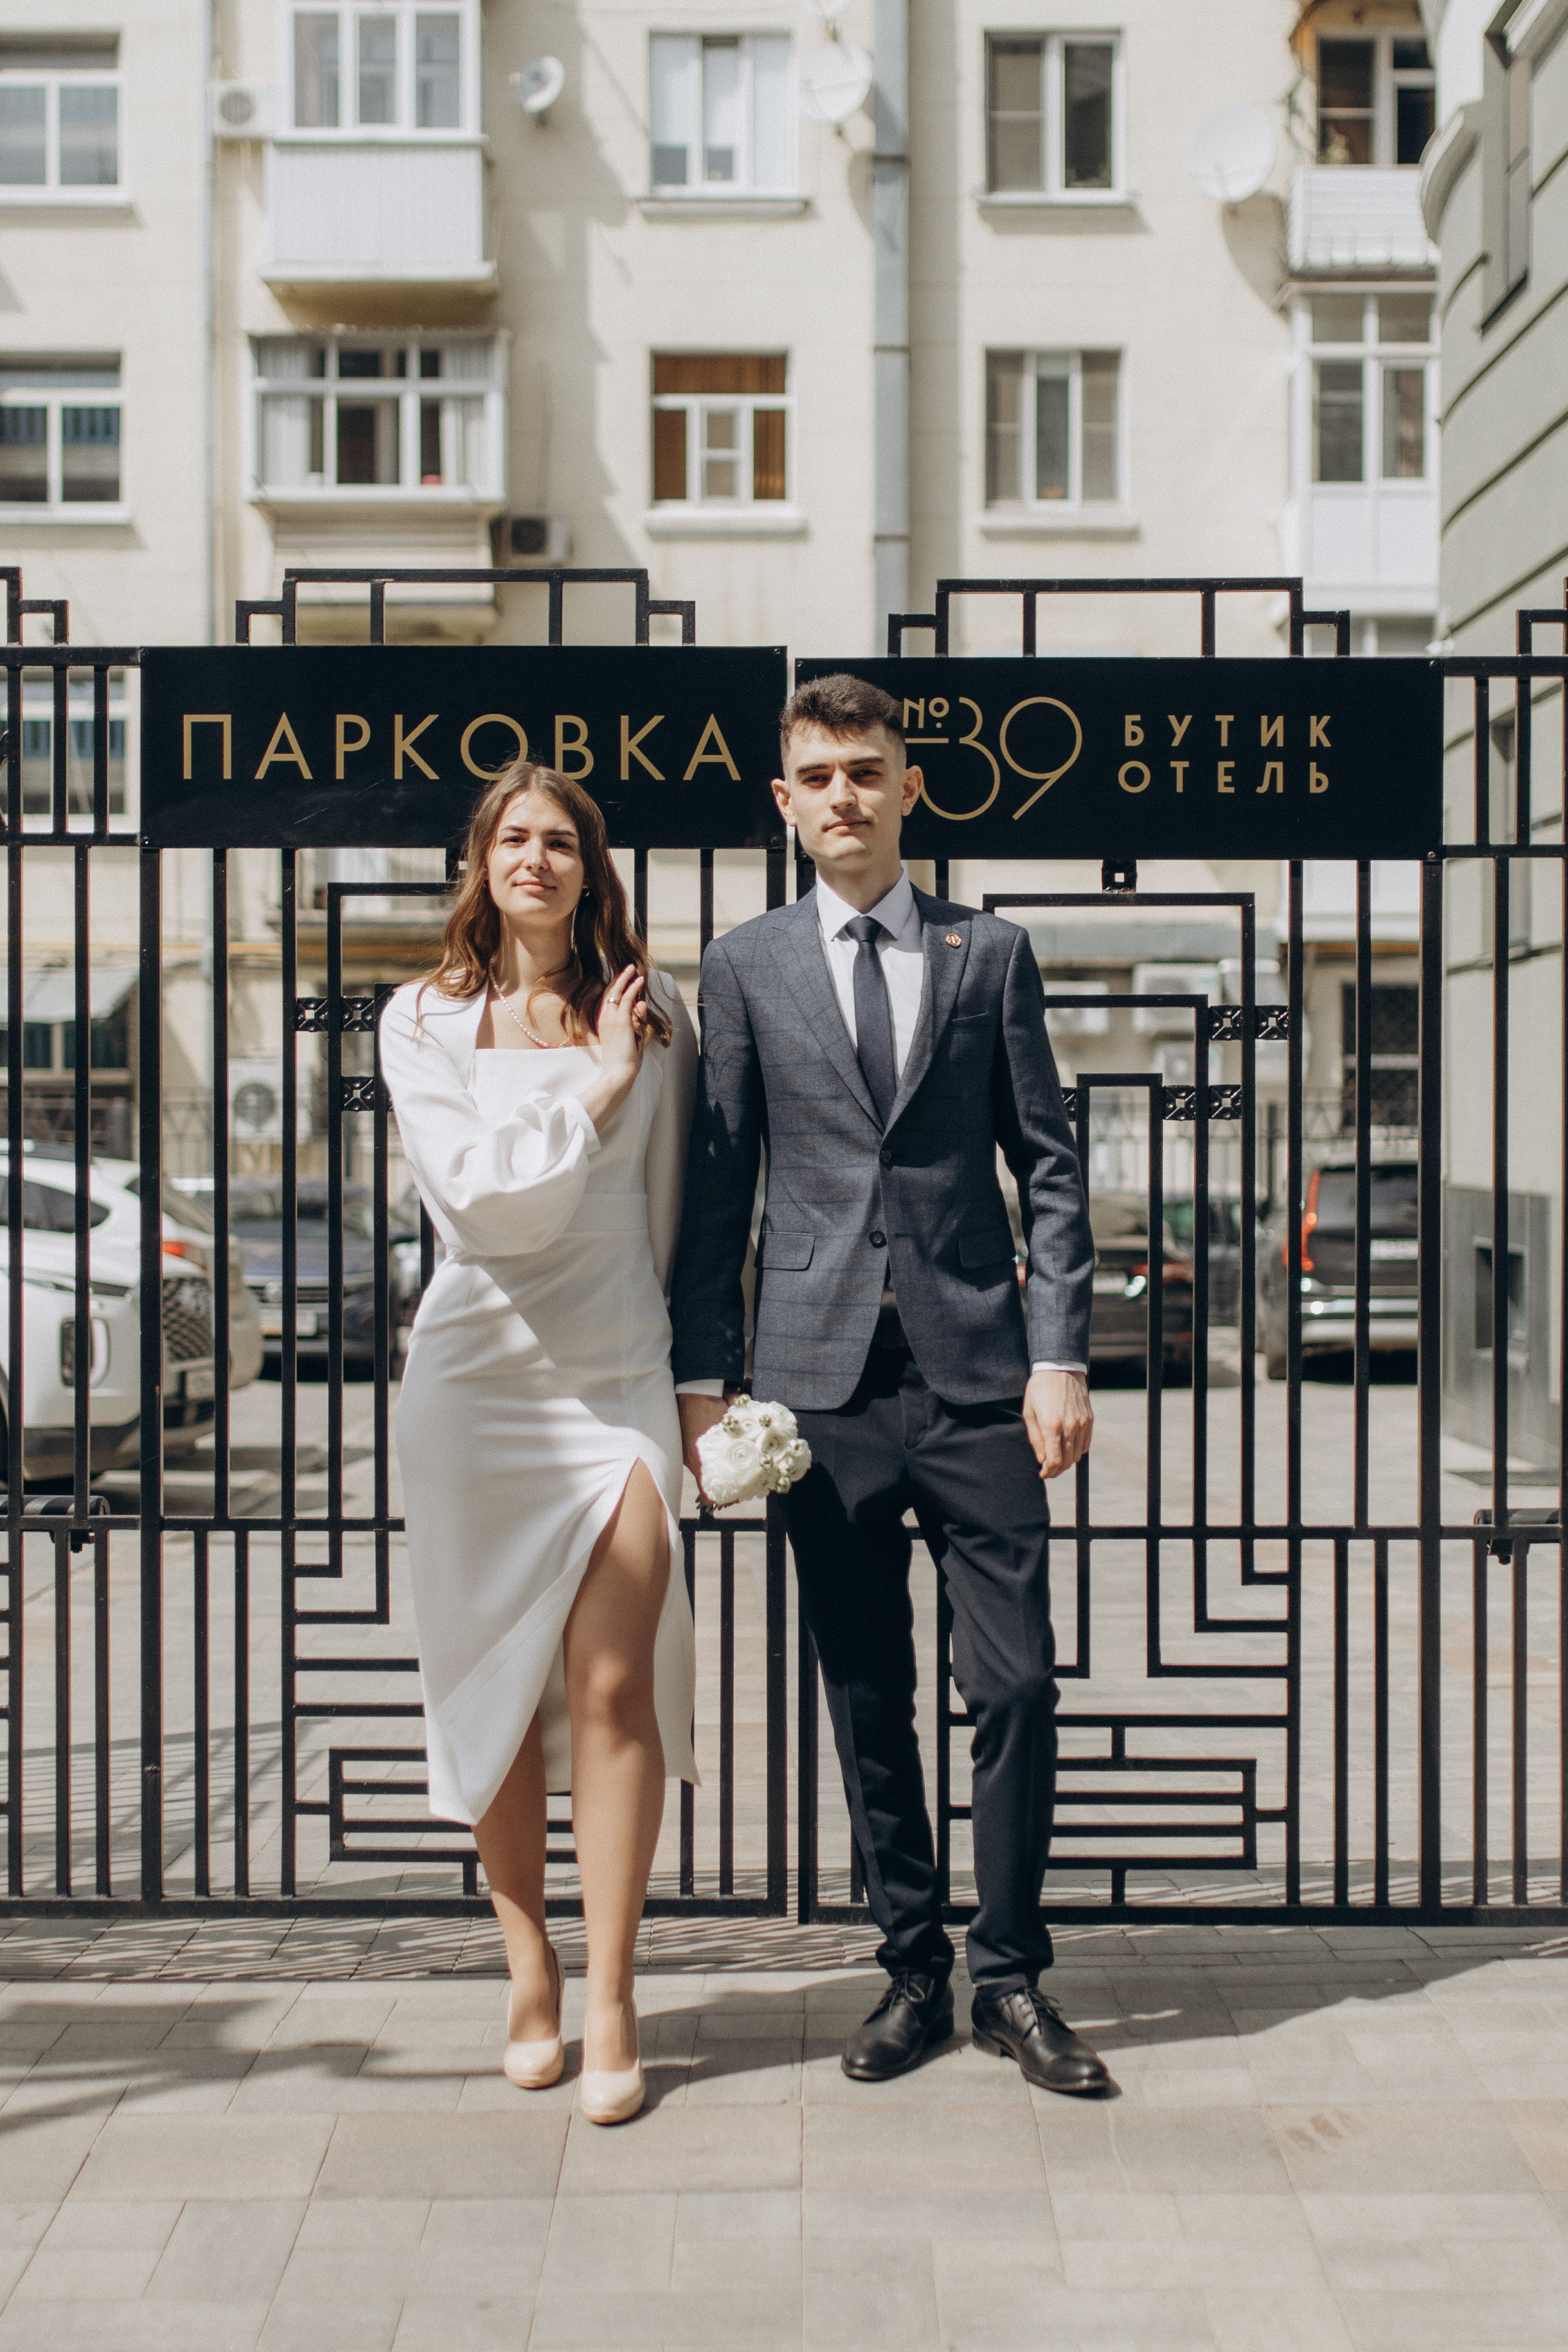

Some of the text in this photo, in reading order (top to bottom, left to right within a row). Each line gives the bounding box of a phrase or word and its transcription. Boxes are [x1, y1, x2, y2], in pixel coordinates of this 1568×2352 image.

[182, 712, 741, 781] ПАРКОВКА
[1124, 714, 1332, 747] БУТИК
[1118, 760, 1329, 794] ОТЕЛЬ
